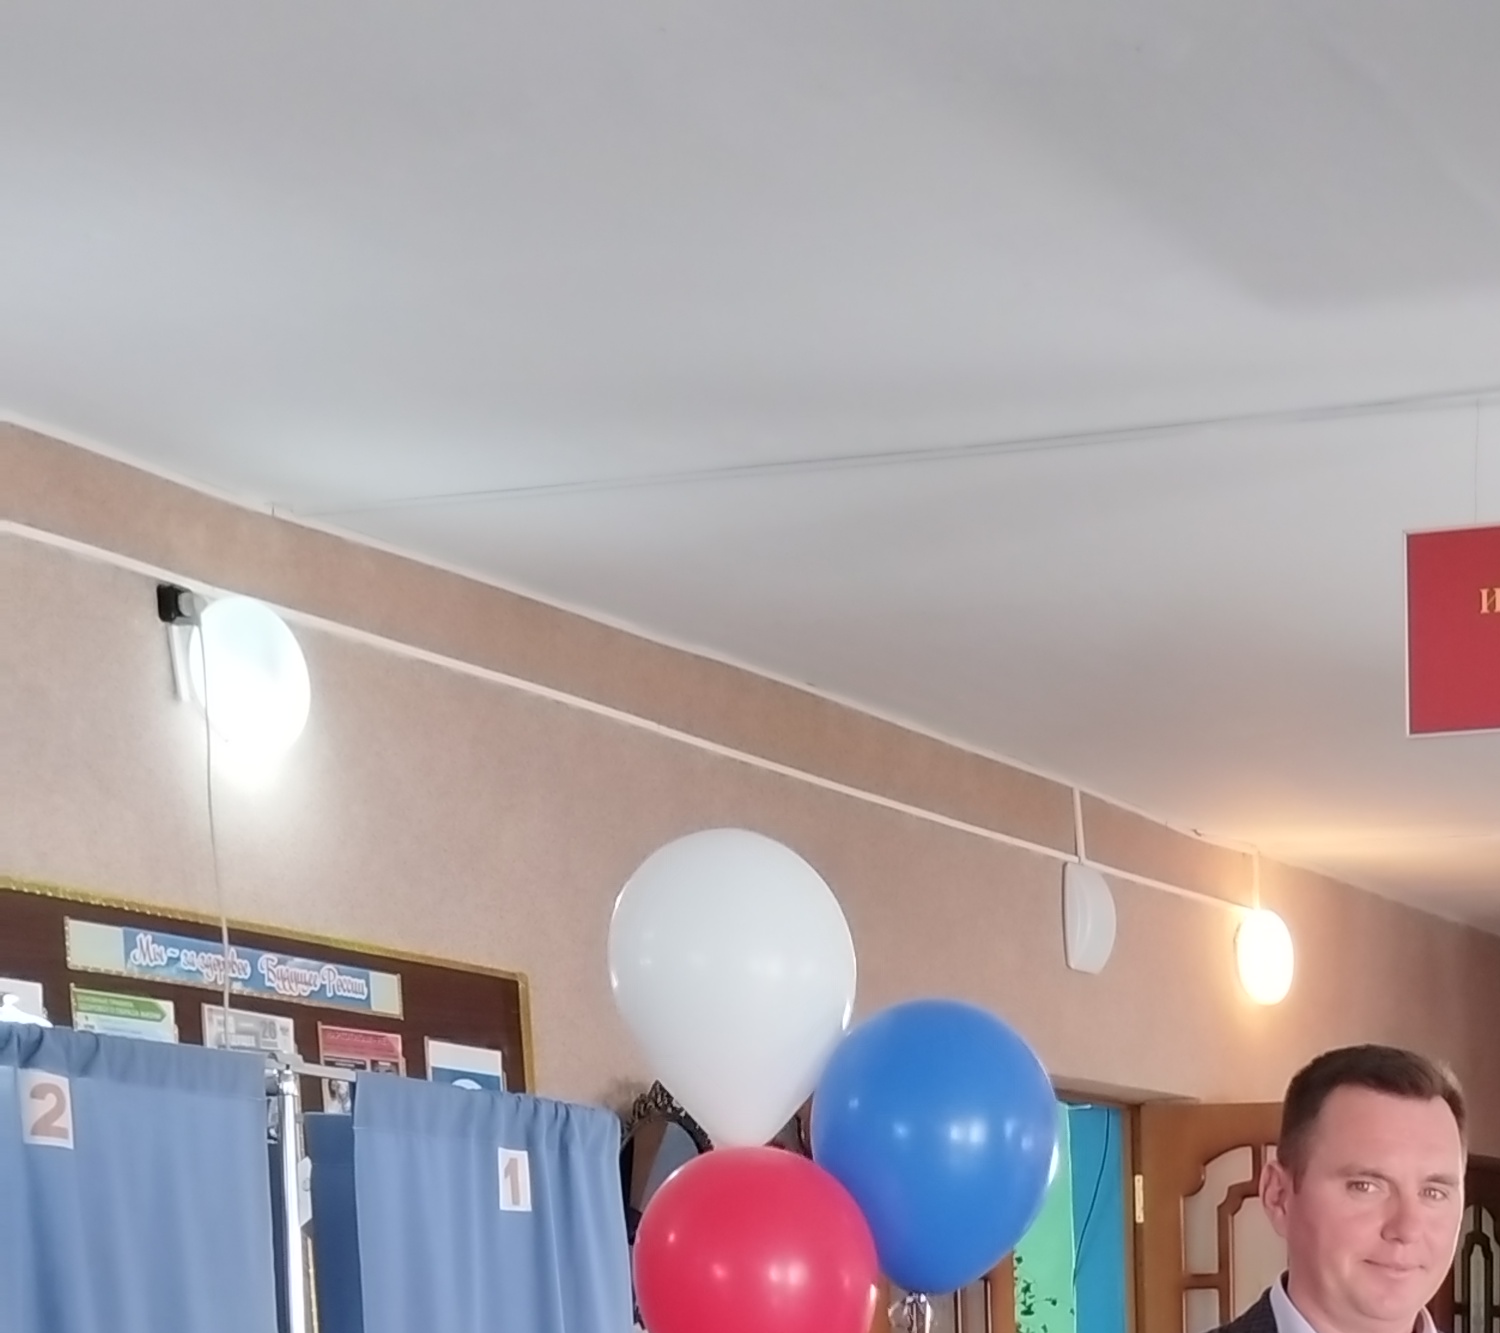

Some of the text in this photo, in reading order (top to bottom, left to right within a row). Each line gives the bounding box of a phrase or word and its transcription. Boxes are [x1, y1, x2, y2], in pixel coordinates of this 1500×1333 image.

[130, 933, 167, 967] Мы
[29, 1081, 70, 1141] 2
[502, 1156, 522, 1207] 1
